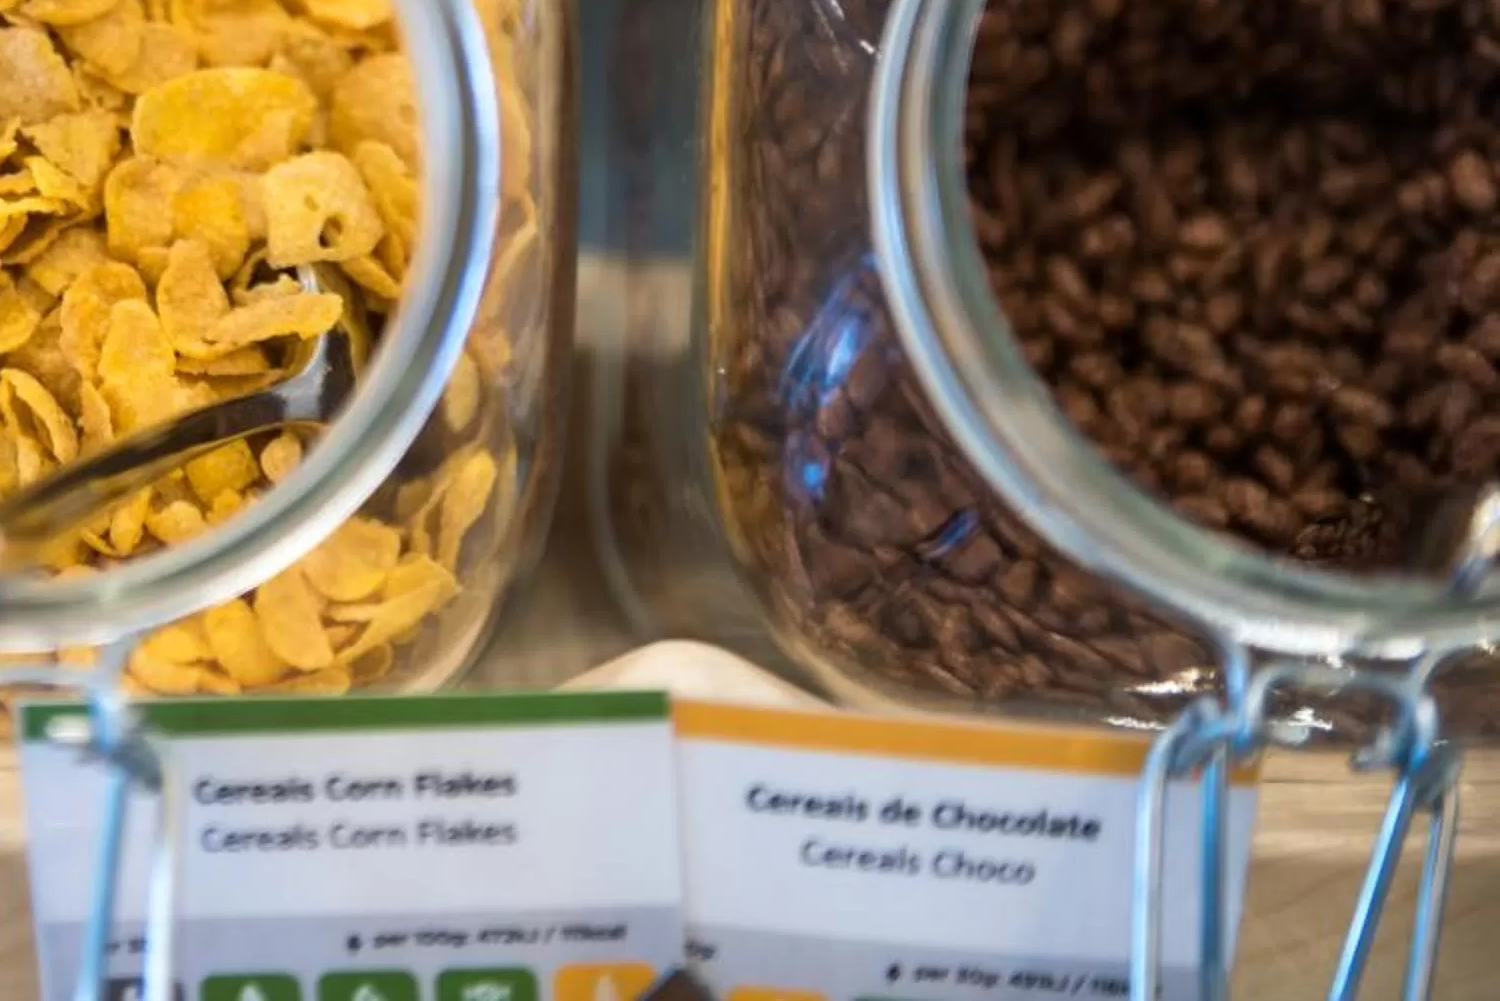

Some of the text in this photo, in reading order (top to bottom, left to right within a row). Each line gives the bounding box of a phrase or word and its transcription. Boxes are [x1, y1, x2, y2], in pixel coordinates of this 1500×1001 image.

[325, 773, 402, 803] Corn
[415, 770, 516, 798] Flakes
[329, 821, 407, 850] Corn
[417, 819, 516, 847] Flakes
[879, 795, 921, 828] de
[932, 799, 1102, 843] Chocolate
[932, 851, 1036, 886] Choco
